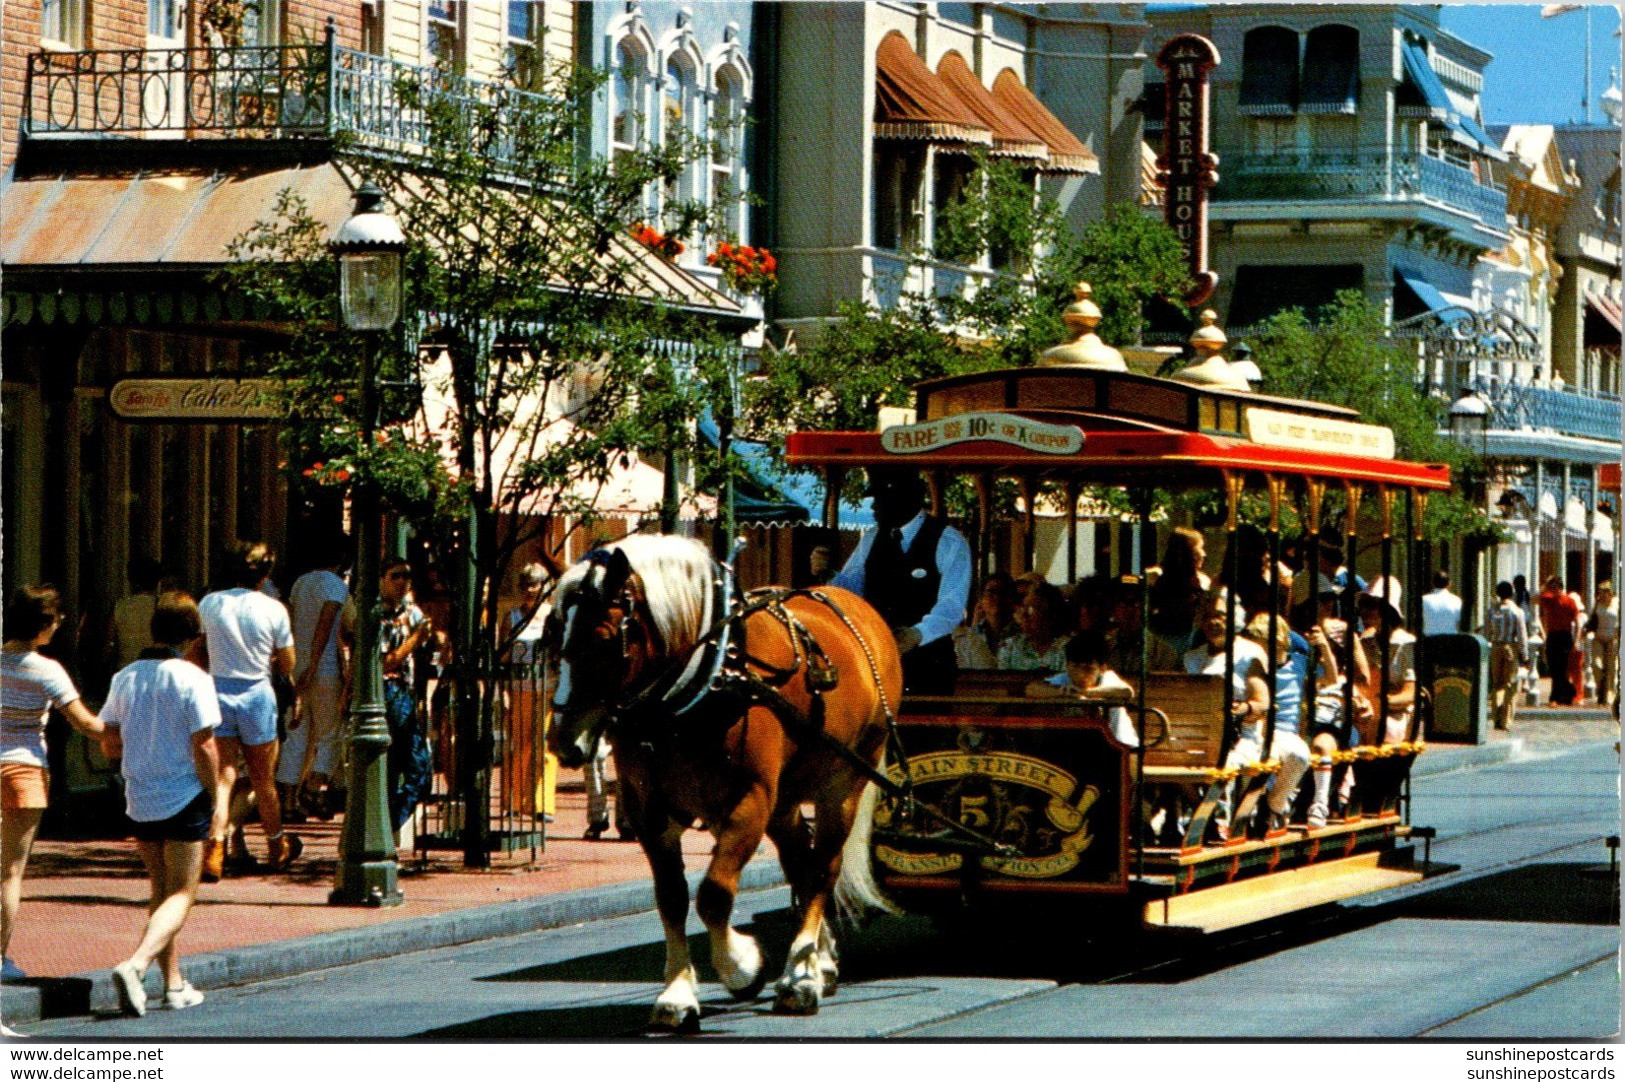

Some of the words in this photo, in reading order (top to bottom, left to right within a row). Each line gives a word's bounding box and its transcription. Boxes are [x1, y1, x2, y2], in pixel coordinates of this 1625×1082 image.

[1177, 62, 1196, 175] MARKET
[1175, 185, 1193, 262] HOUS
[893, 426, 938, 449] FARE
[1002, 423, 1016, 436] OR
[1018, 425, 1028, 444] A
[1029, 432, 1071, 448] COUPON
[966, 757, 1059, 785] STREET
[960, 795, 990, 828] 5
